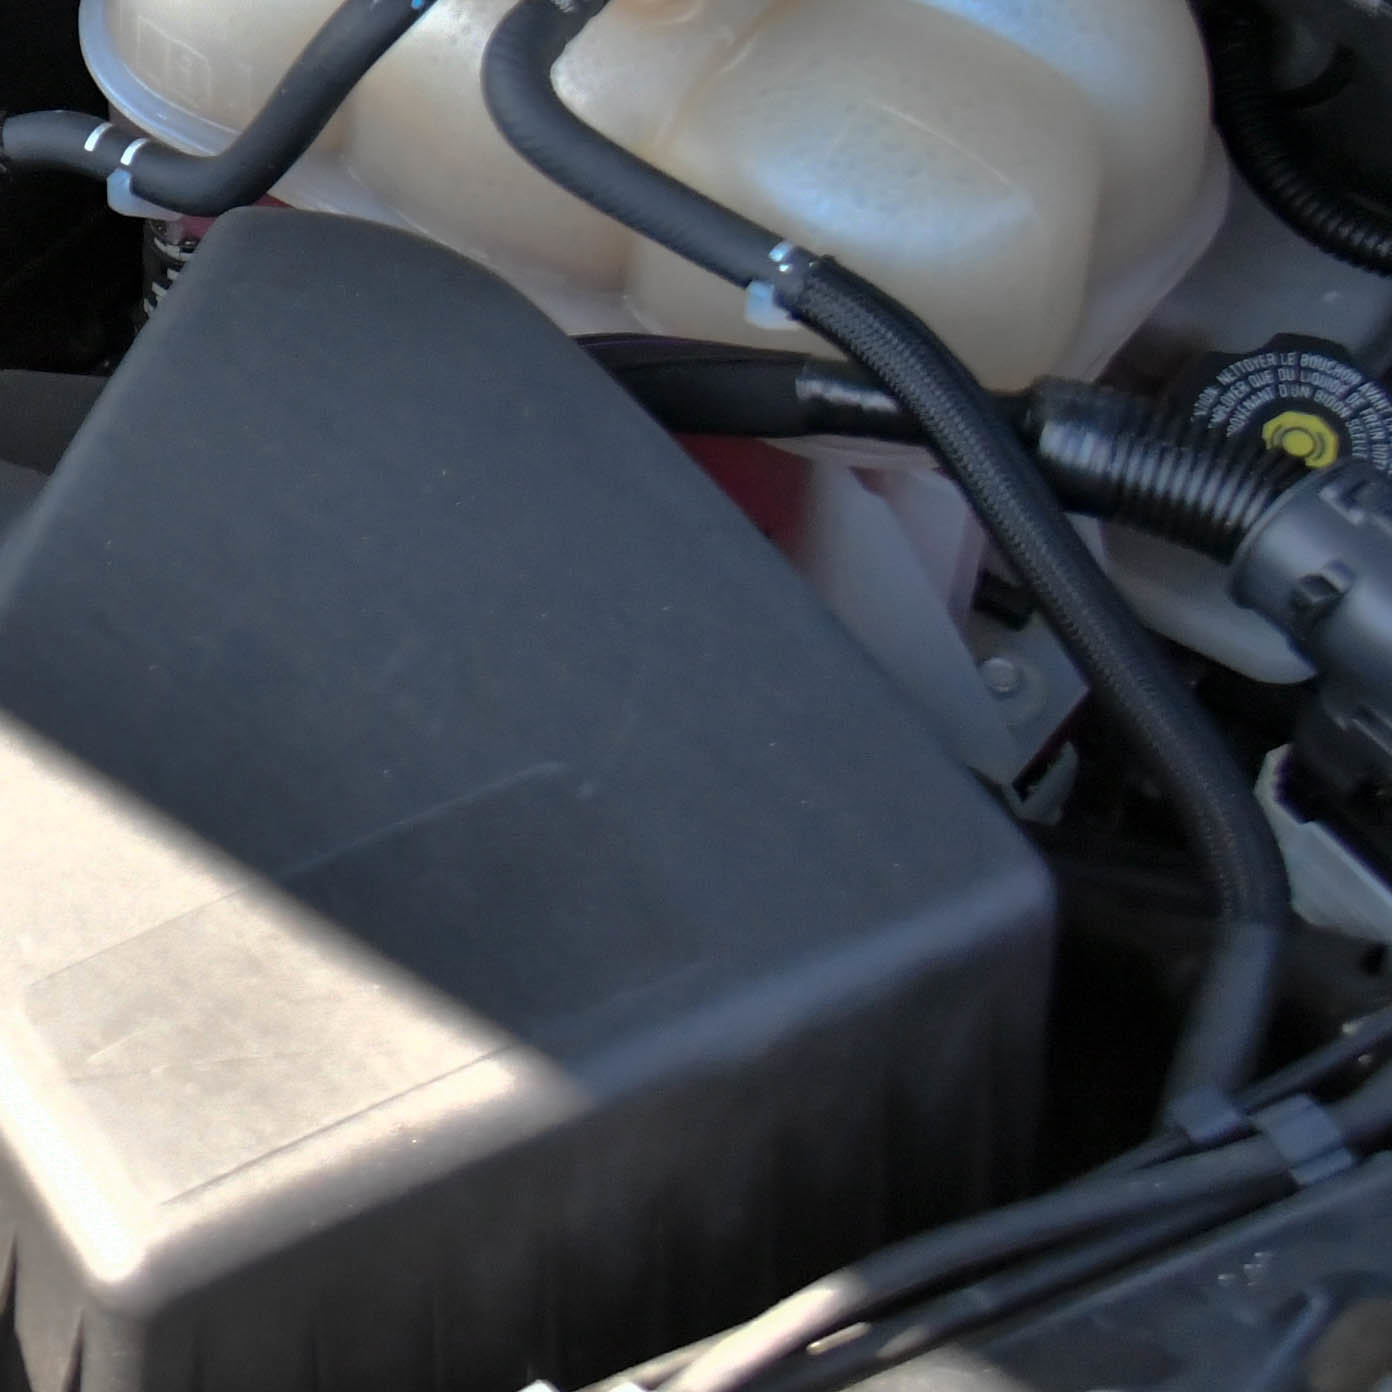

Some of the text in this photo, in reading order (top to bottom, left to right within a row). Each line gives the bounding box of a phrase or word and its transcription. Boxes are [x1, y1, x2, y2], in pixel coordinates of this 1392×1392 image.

[1216, 353, 1277, 386] NETTOYER
[1280, 352, 1297, 366] LE
[1300, 353, 1363, 386] BOUCHON
[1247, 369, 1275, 388] QUE
[1278, 368, 1295, 381] DU
